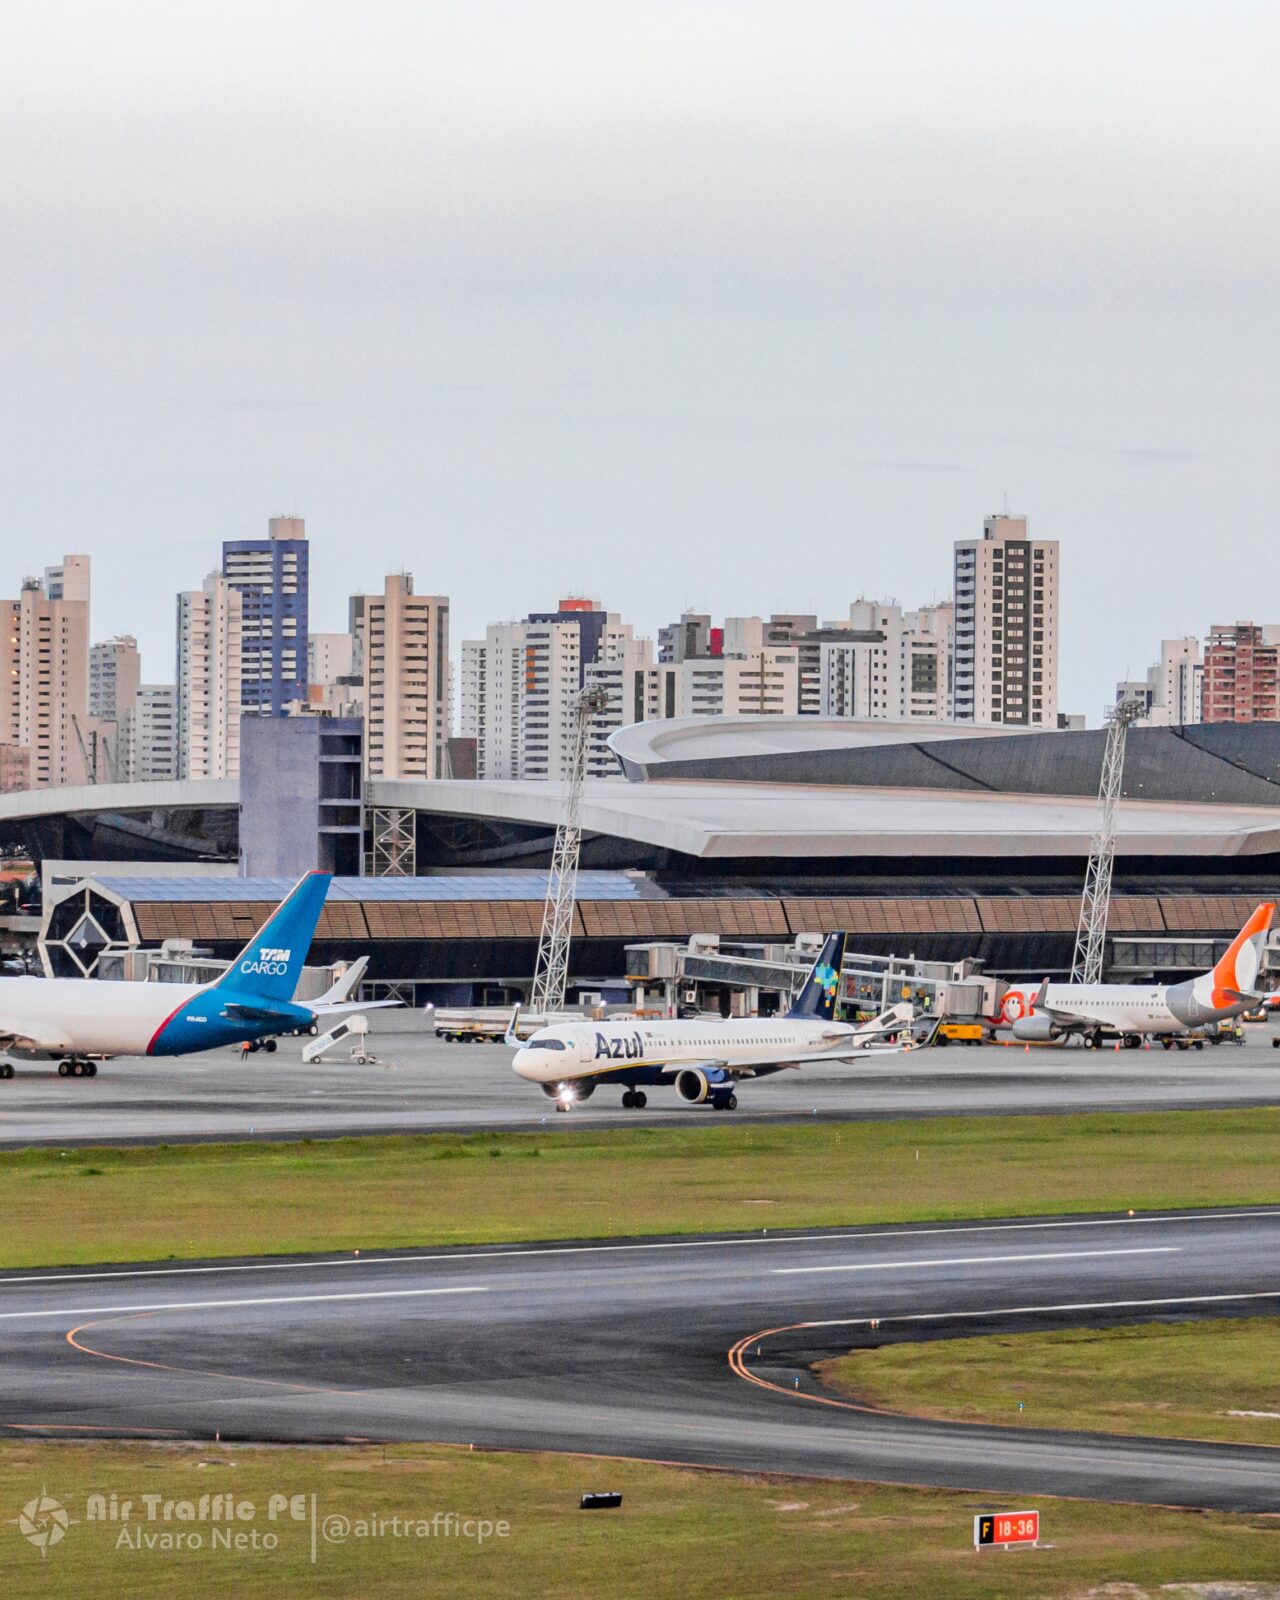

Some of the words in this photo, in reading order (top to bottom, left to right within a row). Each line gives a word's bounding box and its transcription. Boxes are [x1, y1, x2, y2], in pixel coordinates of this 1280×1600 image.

[260, 948, 291, 961] TAM
[241, 960, 288, 975] CARGO
[594, 1031, 644, 1059] Azul
[982, 1522, 991, 1539] F
[998, 1519, 1034, 1537] 18-36
